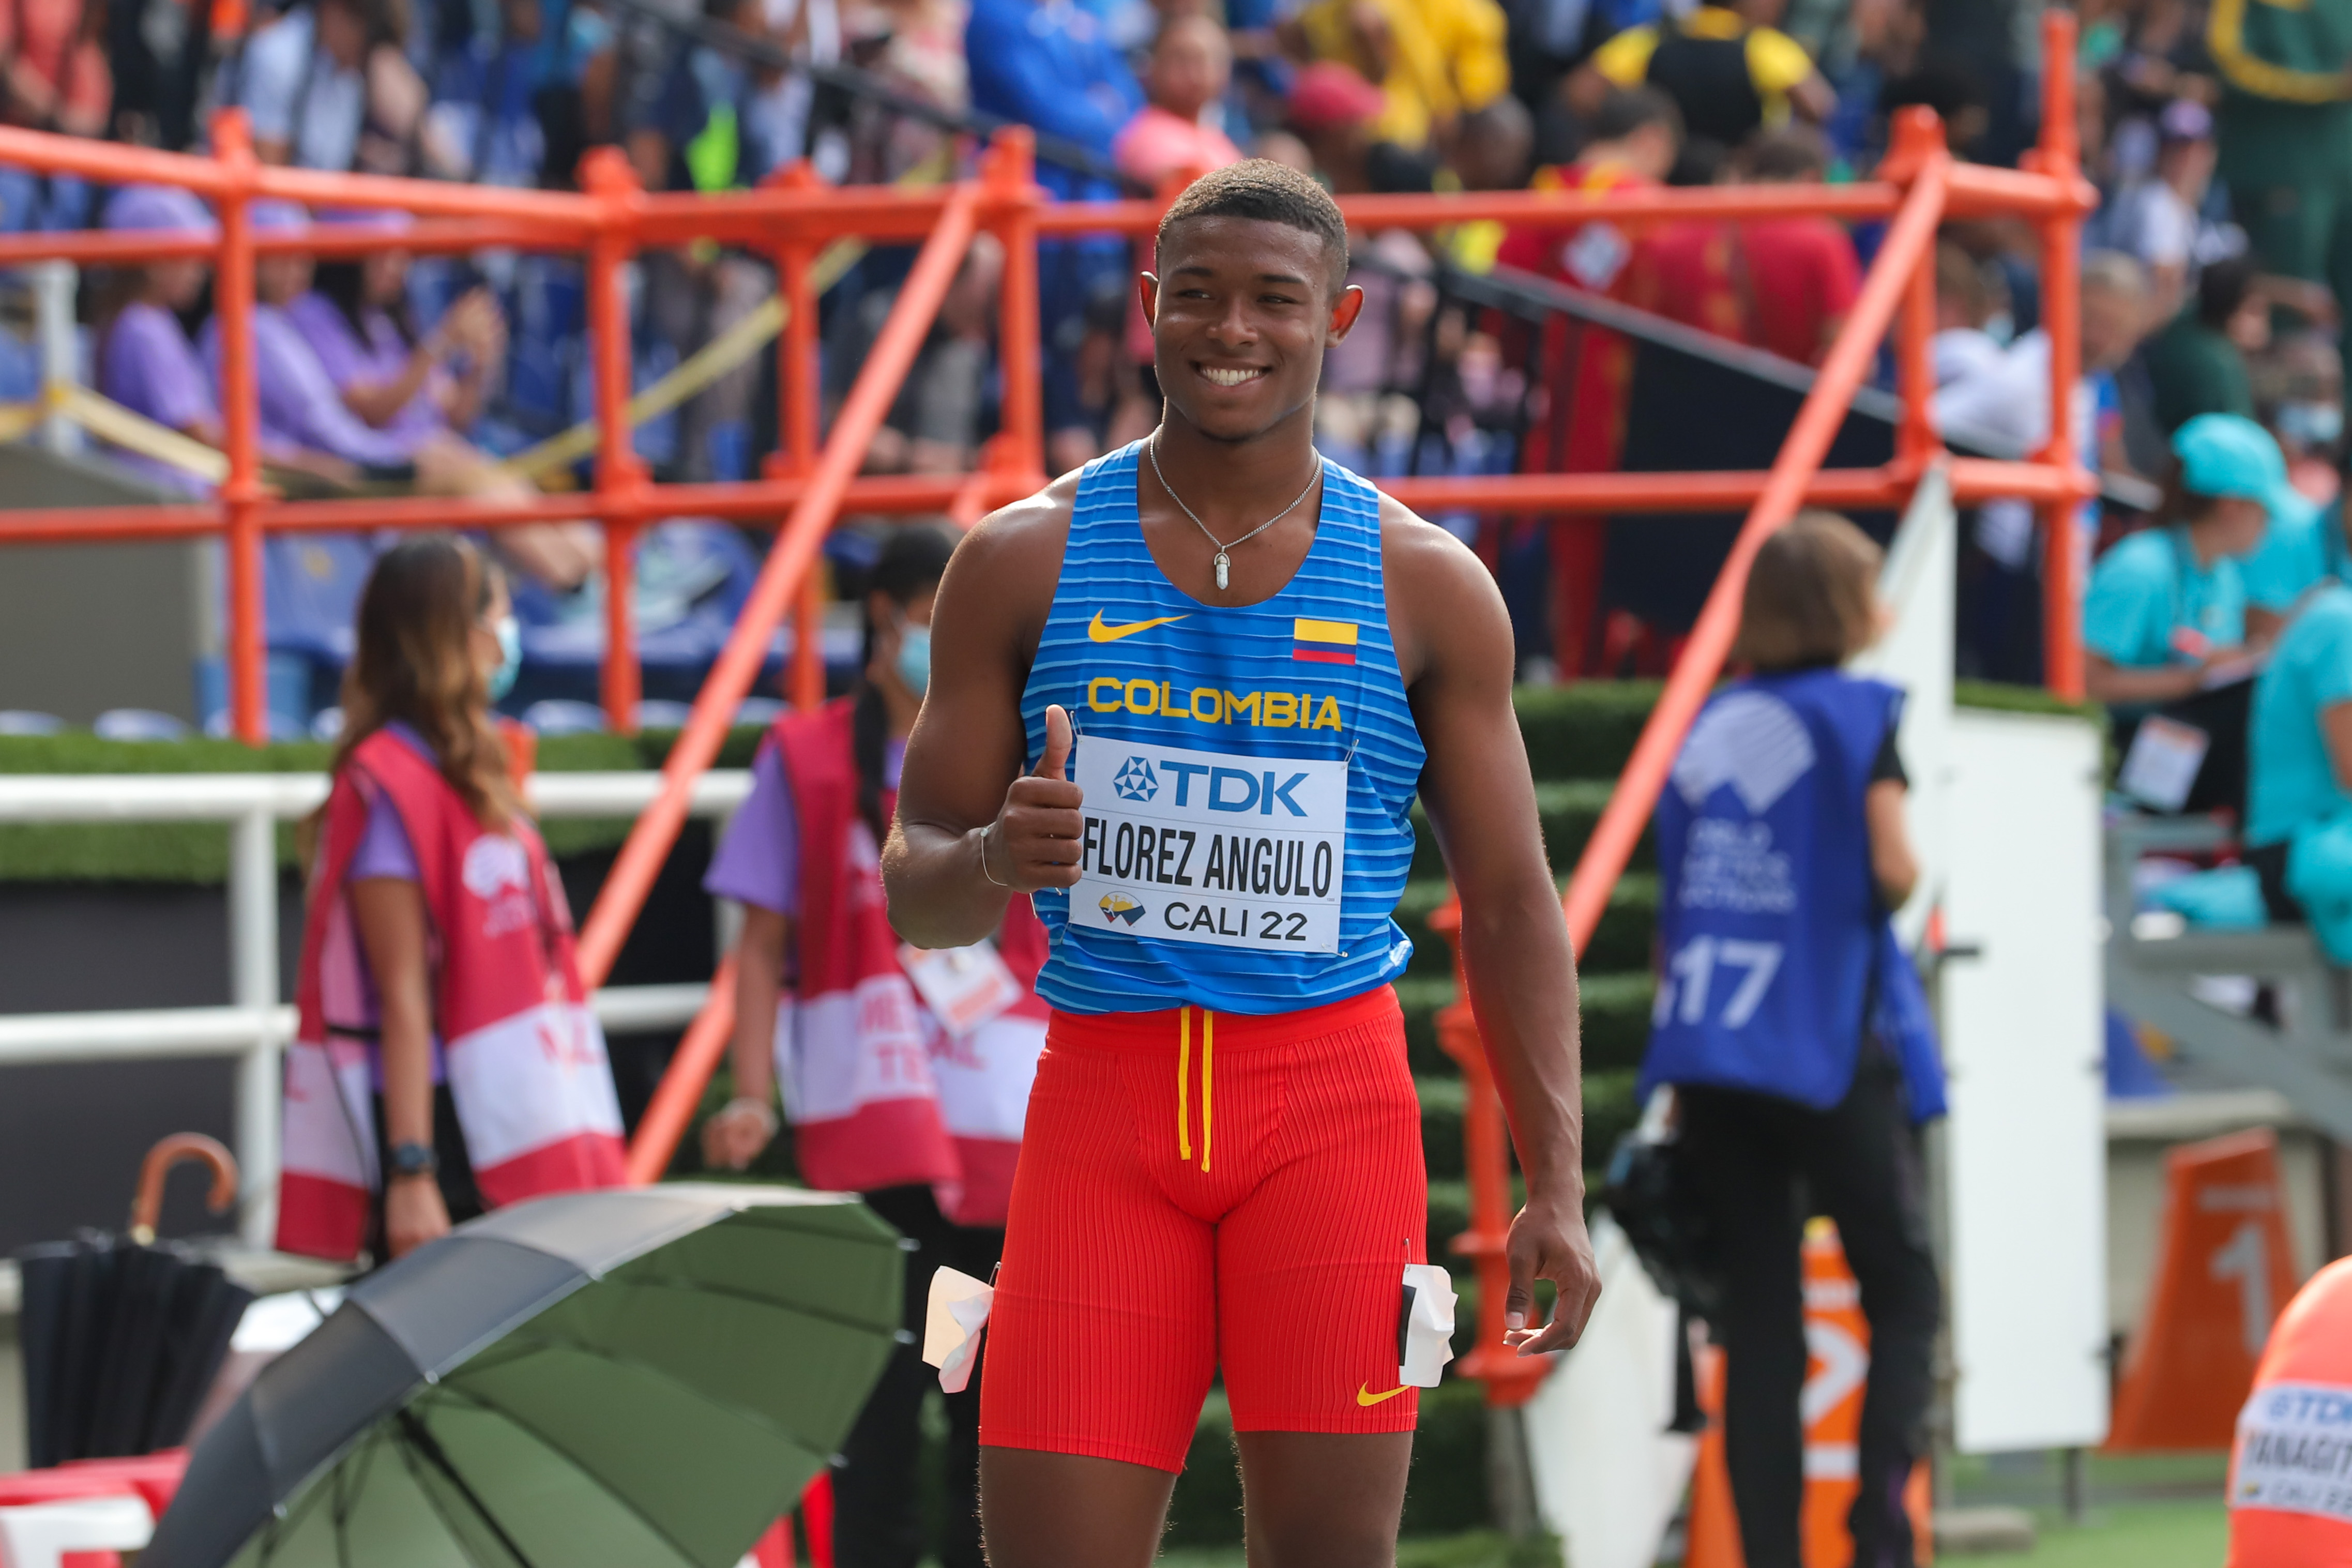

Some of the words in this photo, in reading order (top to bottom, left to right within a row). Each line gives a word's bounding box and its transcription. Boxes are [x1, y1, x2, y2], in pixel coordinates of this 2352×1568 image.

[1088, 677, 1342, 732] COLOMBIA
[1160, 760, 1310, 817] TDK
[1083, 817, 1196, 887] FLOREZ
[1203, 834, 1332, 898] ANGULO
[1164, 902, 1248, 937] CALI
[1260, 911, 1308, 941] 22
[2212, 1223, 2276, 1358] 1
